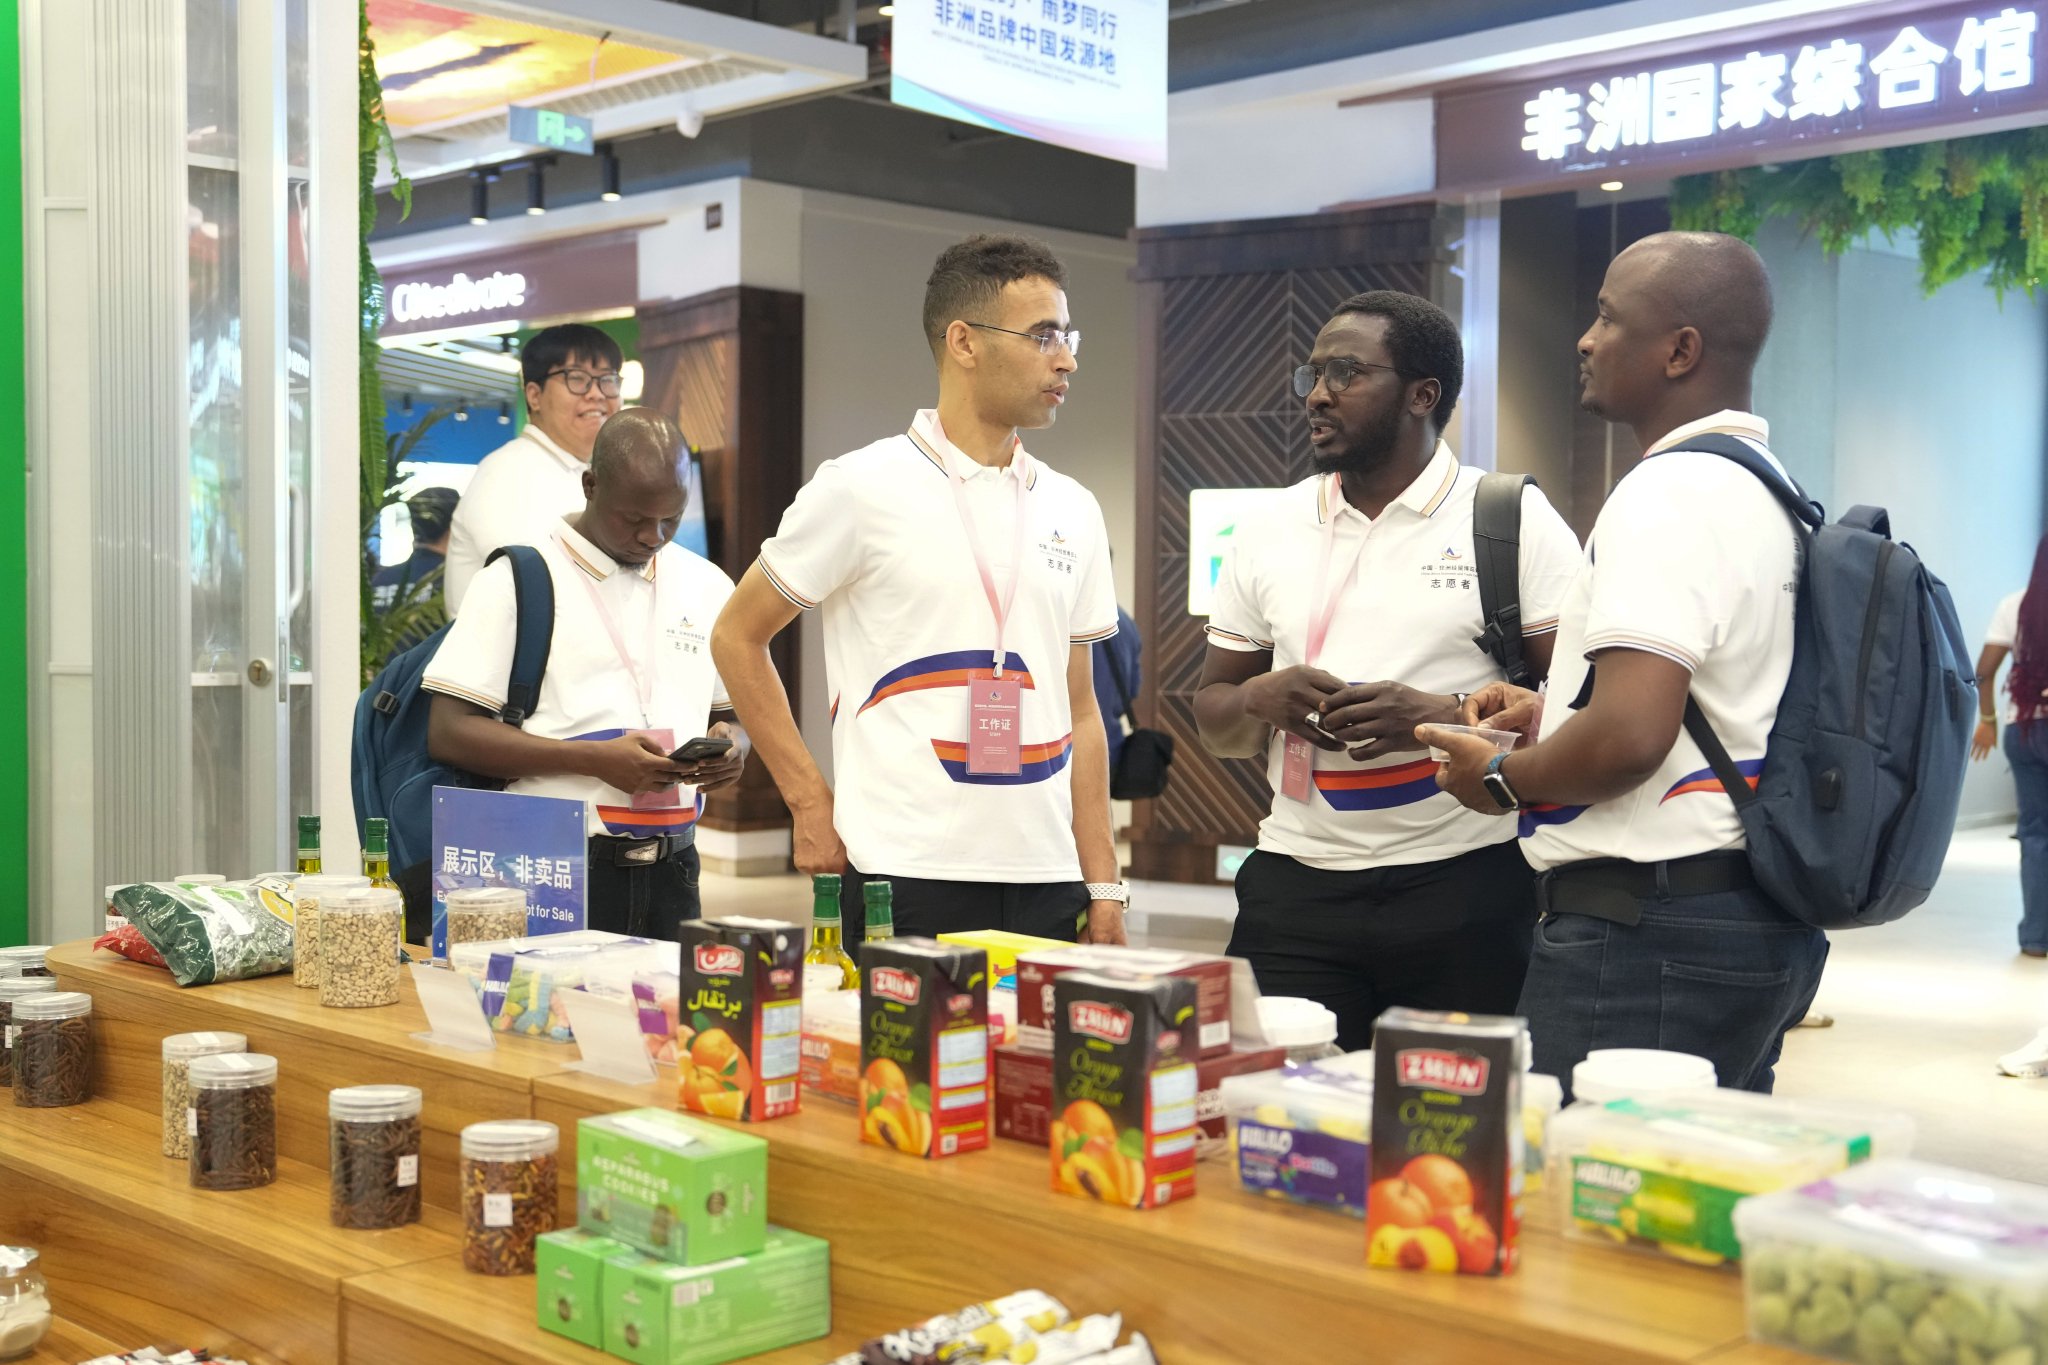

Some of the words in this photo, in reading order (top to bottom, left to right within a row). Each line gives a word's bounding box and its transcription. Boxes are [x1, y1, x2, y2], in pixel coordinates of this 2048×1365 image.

[1521, 8, 2038, 161] 非洲国家综合馆
[1431, 578, 1471, 590] 志愿者
[979, 718, 1012, 731] 工作证
[443, 845, 572, 890] 展示区，非卖品
[536, 904, 550, 918] for
[552, 908, 574, 922] Sale
[687, 989, 742, 1019] برتقال
[593, 1155, 670, 1193] ASPARAGUS
[602, 1173, 660, 1205] COOKIES
